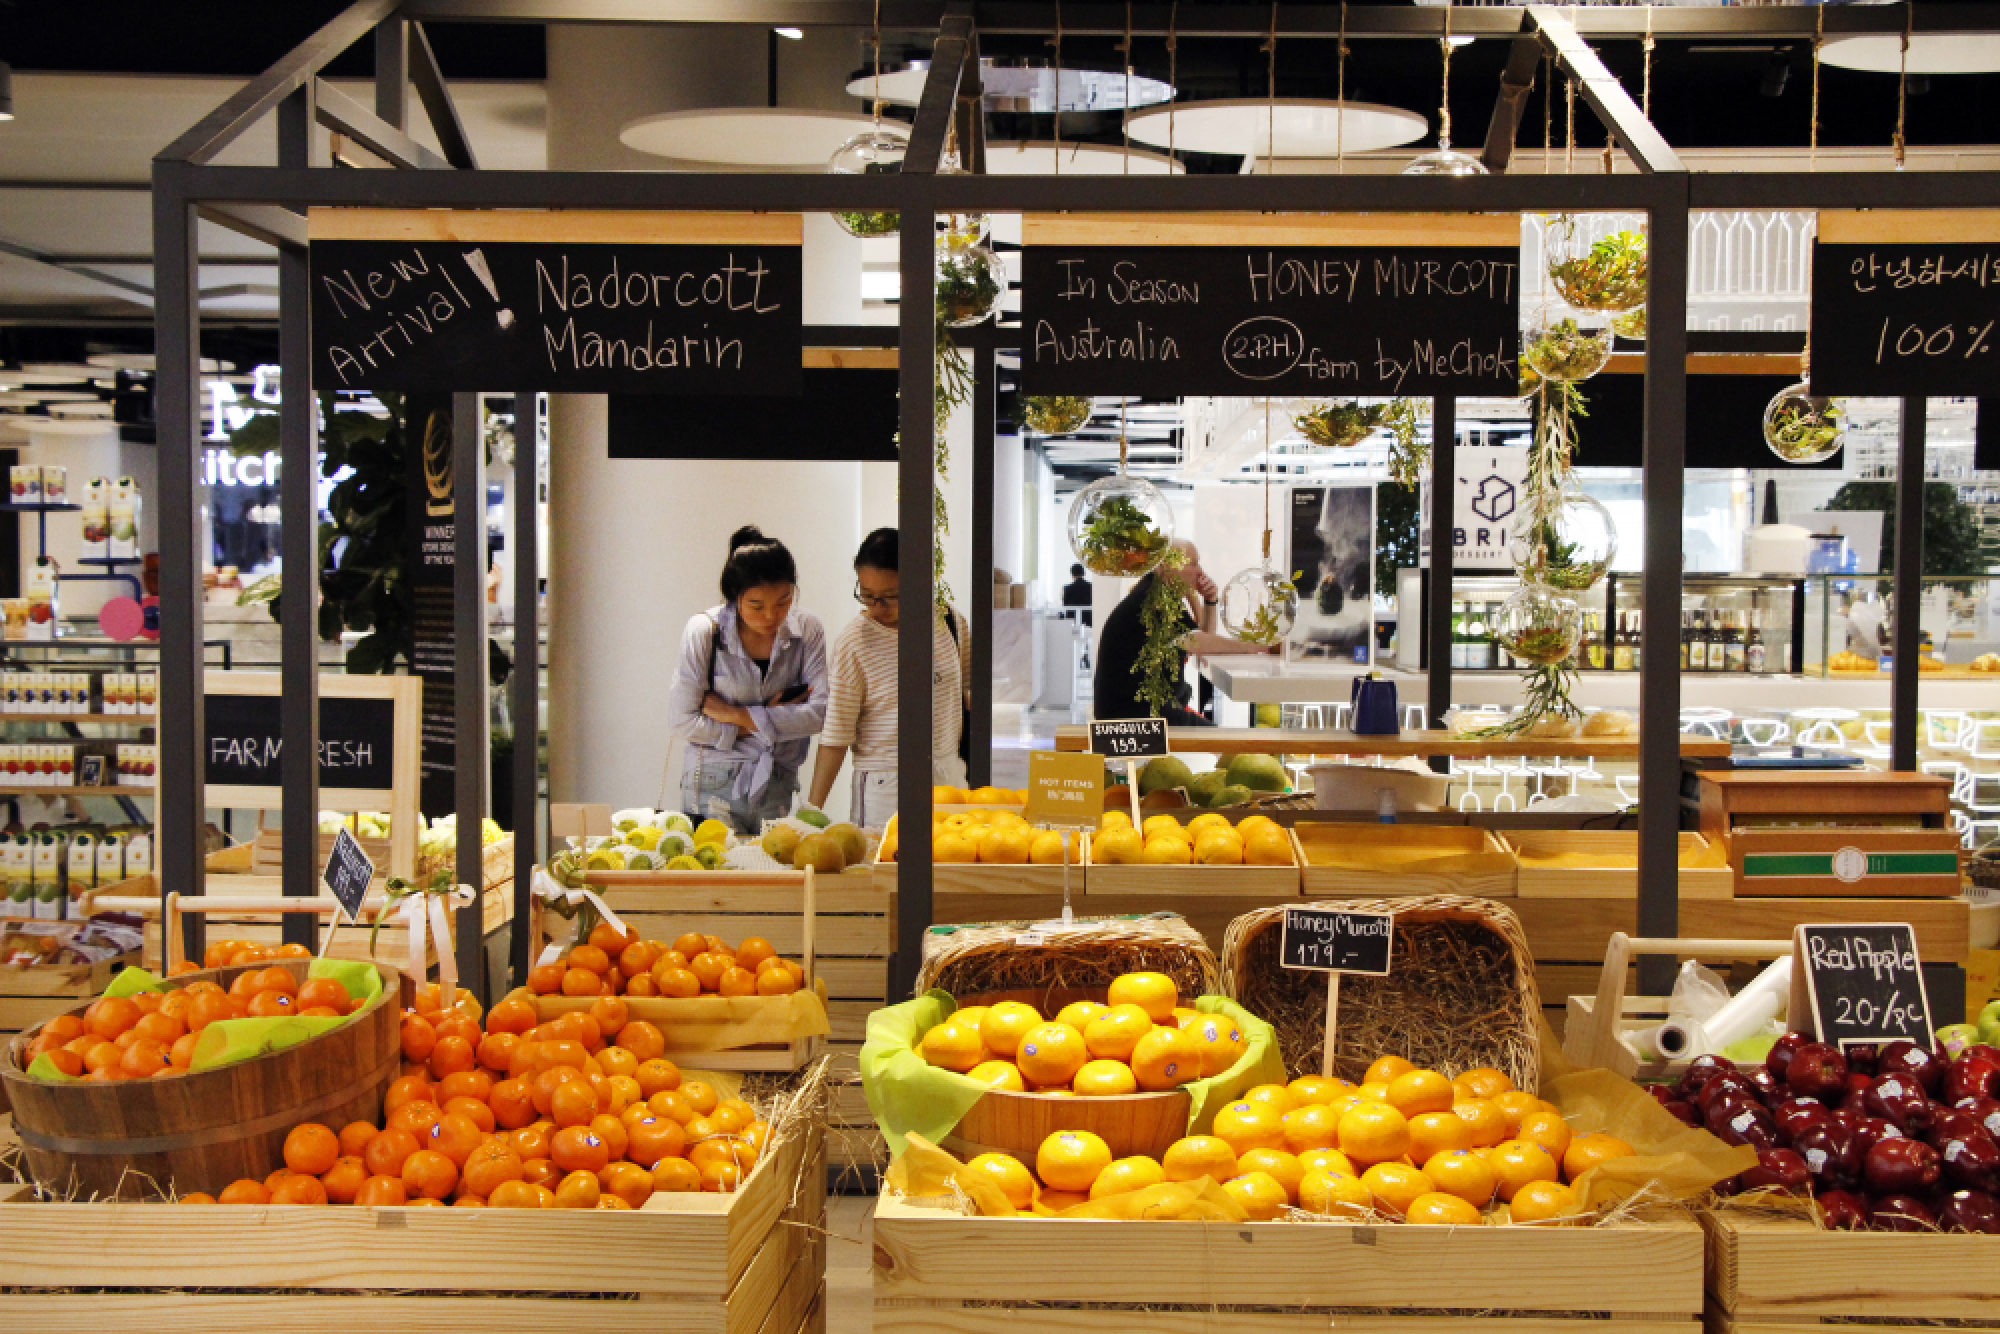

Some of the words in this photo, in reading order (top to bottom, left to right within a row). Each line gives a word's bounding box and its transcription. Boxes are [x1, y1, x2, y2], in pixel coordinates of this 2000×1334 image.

[322, 248, 429, 318] New
[535, 252, 781, 314] Nadorcott
[1056, 259, 1096, 301] In
[1107, 260, 1199, 305] Season
[1247, 251, 1360, 302] HONEY
[1373, 254, 1517, 305] MURCOTT
[543, 316, 743, 372] Mandarin
[1035, 317, 1181, 364] Australia
[1300, 347, 1359, 381] farm
[1875, 315, 1995, 365] 100%
[211, 735, 282, 768] FARM
[318, 739, 373, 768] RESH
[1095, 721, 1161, 737] SUNQUICK
[1287, 911, 1335, 945] Honey
[1335, 914, 1391, 937] Murcott
[1810, 935, 1856, 971] Red
[1853, 933, 1915, 984] Apple
